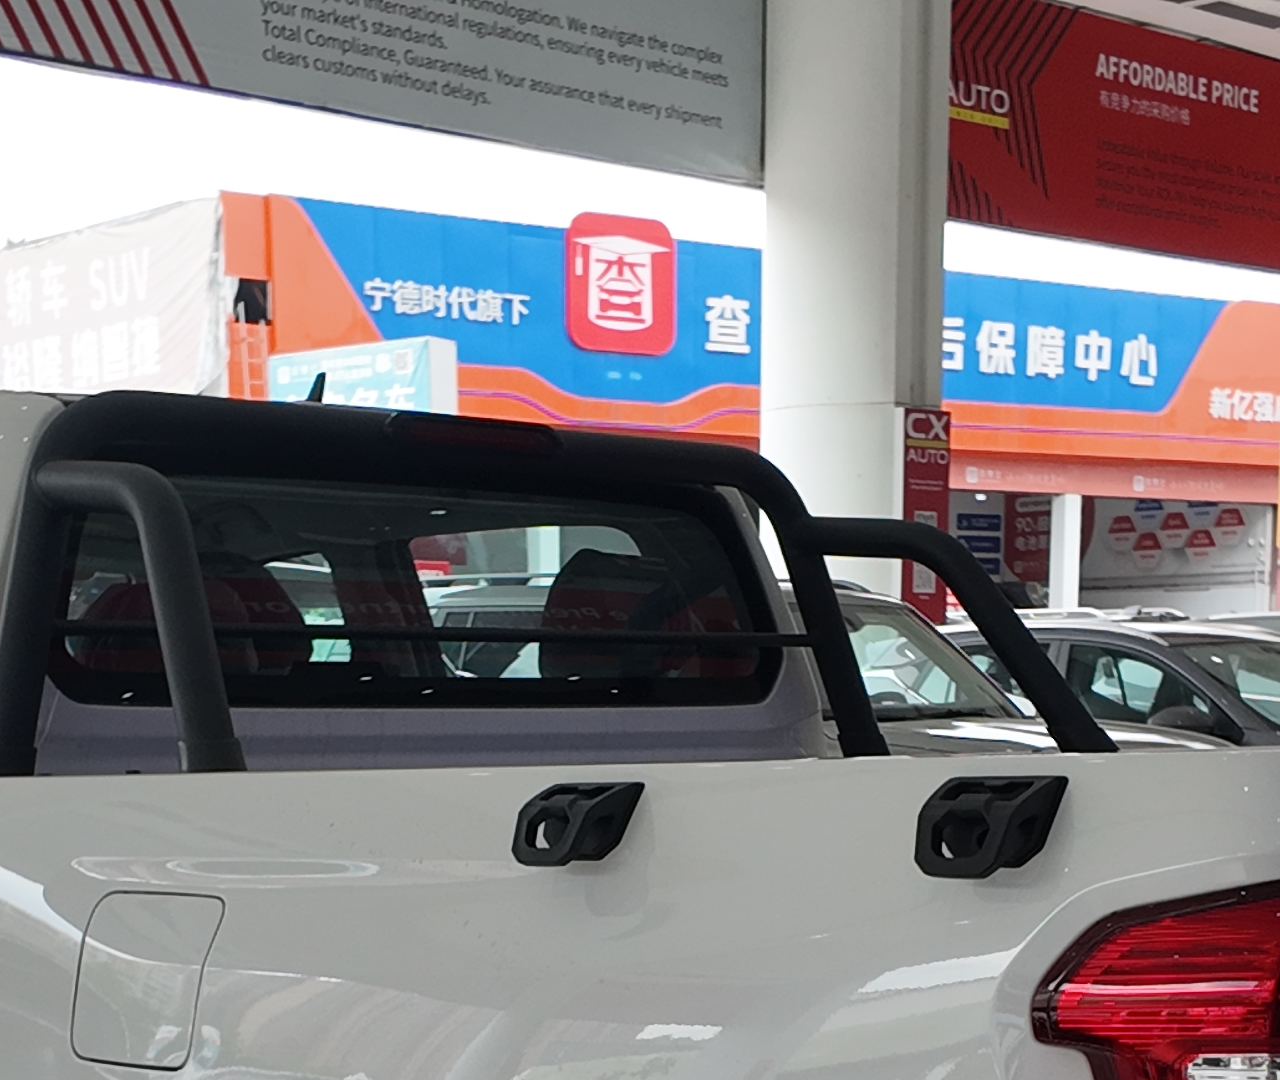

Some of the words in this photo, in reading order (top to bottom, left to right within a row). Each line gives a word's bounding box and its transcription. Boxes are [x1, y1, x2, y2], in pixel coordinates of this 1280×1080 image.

[261, 0, 297, 17] your
[301, 4, 369, 33] market's
[370, 20, 449, 50] standards.
[462, 17, 545, 51] regulations,
[547, 35, 605, 65] ensuring
[607, 48, 643, 73] every
[645, 58, 689, 80] vehicle
[691, 68, 729, 88] meets
[567, 15, 588, 35] We
[590, 23, 645, 48] navigate
[647, 34, 668, 53] the
[671, 41, 724, 65] complex
[261, 20, 301, 43] Total
[304, 28, 400, 66] Compliance,
[403, 49, 492, 82] Guaranteed.
[494, 66, 526, 89] Your
[528, 77, 596, 104] assurance
[598, 90, 625, 110] that
[627, 98, 662, 120] every
[664, 104, 723, 129] shipment
[262, 45, 310, 69] clears
[313, 56, 378, 83] customs
[380, 69, 438, 94] without
[440, 80, 491, 106] delays.
[1095, 52, 1207, 103] AFFORDABLE
[1211, 81, 1260, 114] PRICE
[88, 247, 150, 311] SUV
[363, 277, 531, 326] 宁德时代旗下
[704, 294, 751, 354] 查
[906, 412, 949, 441] CX
[906, 450, 949, 464] AUTO
